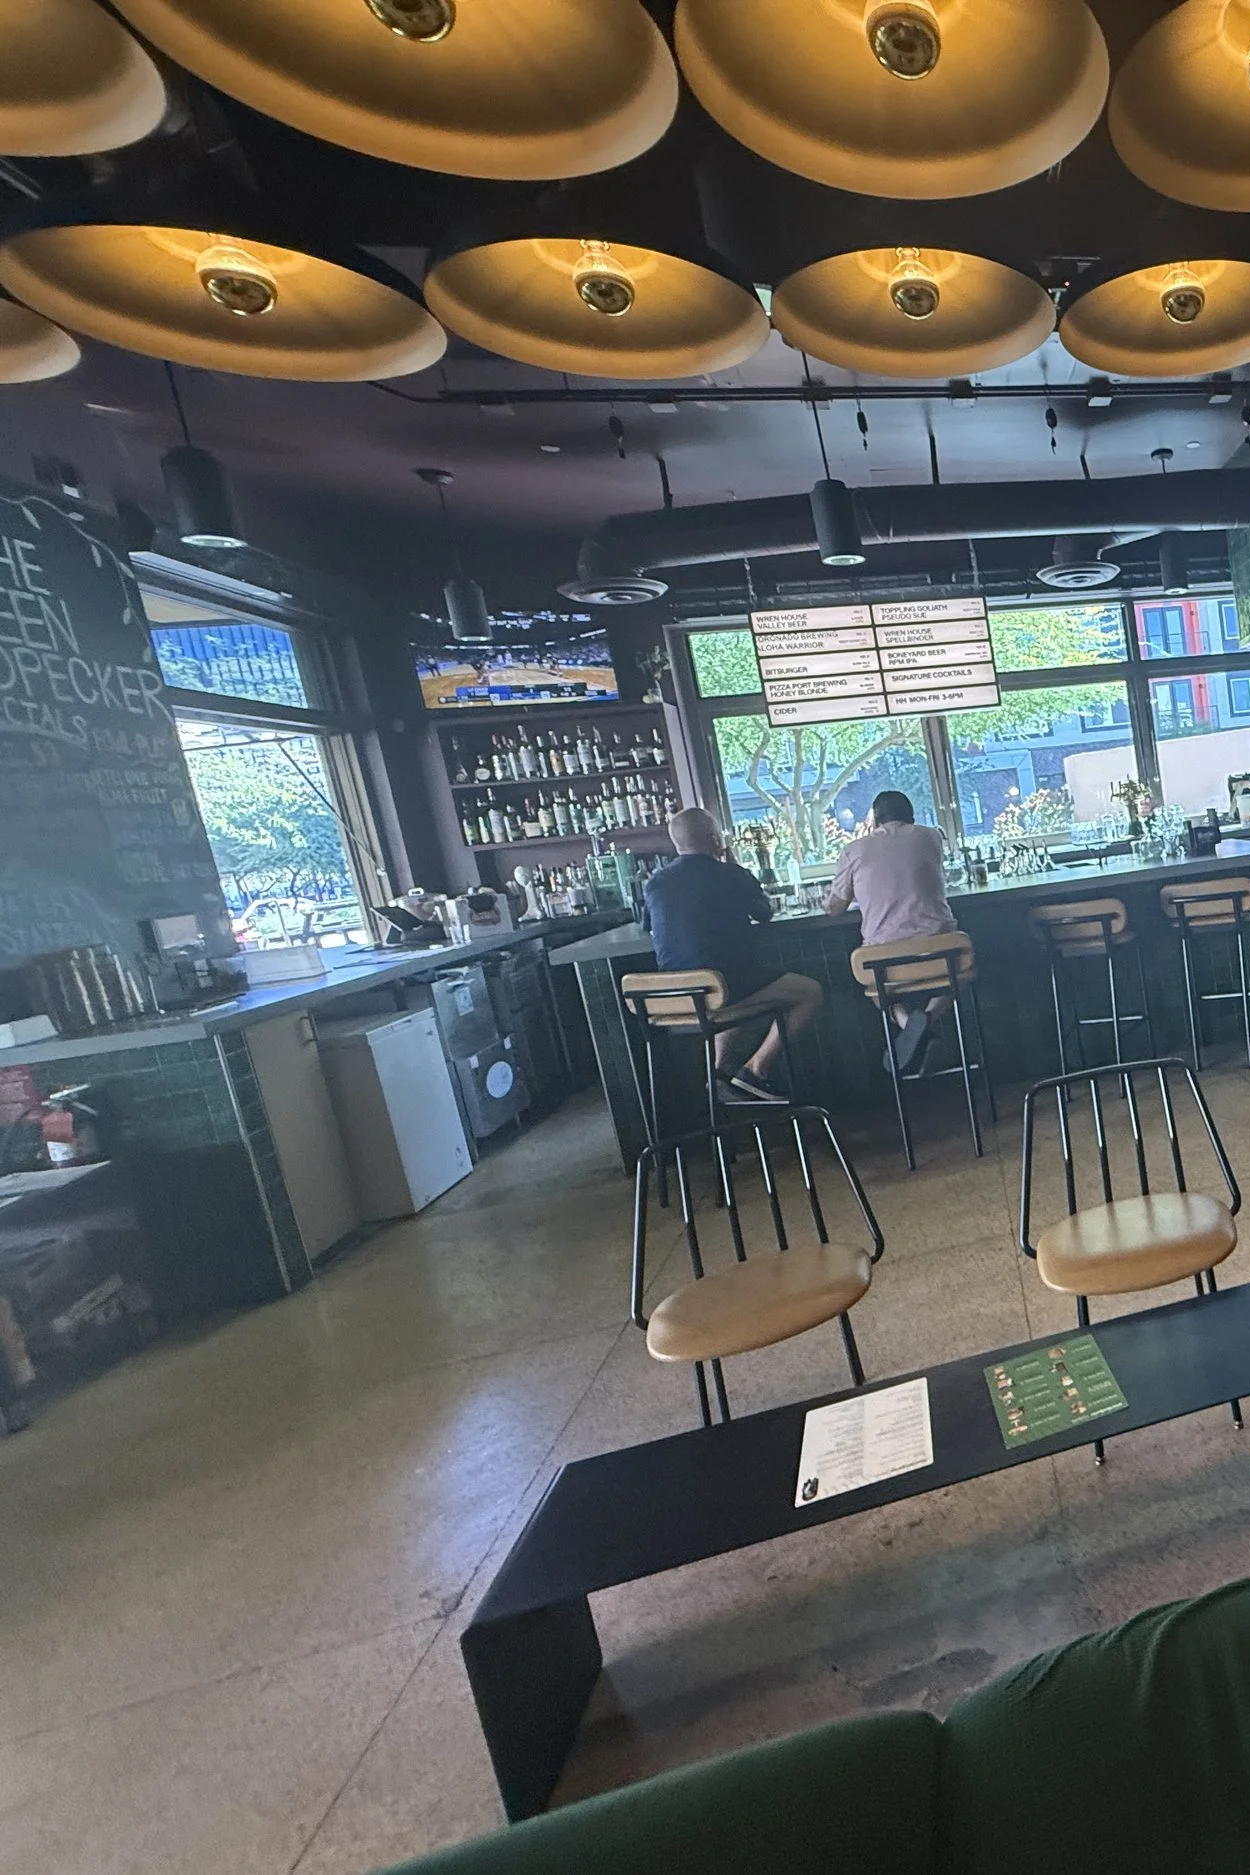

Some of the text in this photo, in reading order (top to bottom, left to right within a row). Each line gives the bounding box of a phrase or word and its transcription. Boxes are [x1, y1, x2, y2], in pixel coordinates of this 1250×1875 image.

[880, 604, 948, 614] TOPPLING GOLIATH
[756, 613, 808, 623] WREN HOUSE
[881, 613, 912, 621] PSEUDO
[757, 620, 808, 630] VALLEY BEER
[801, 630, 839, 640] BREWING
[884, 627, 932, 638] WREN HOUSE
[885, 635, 934, 644] SPELLBINDER
[785, 641, 824, 651] WARRIOR
[887, 648, 947, 659] BONEYARD BEER
[888, 658, 906, 666] RPM
[765, 666, 808, 676] BITBURGER
[891, 669, 973, 682] SIGNATURE COCKTAILS
[769, 679, 848, 692] PIZZA PORT BREWING
[770, 687, 829, 699] HONEY BLONDE
[908, 694, 940, 703] MON-FRI
[773, 707, 798, 716] CIDER
